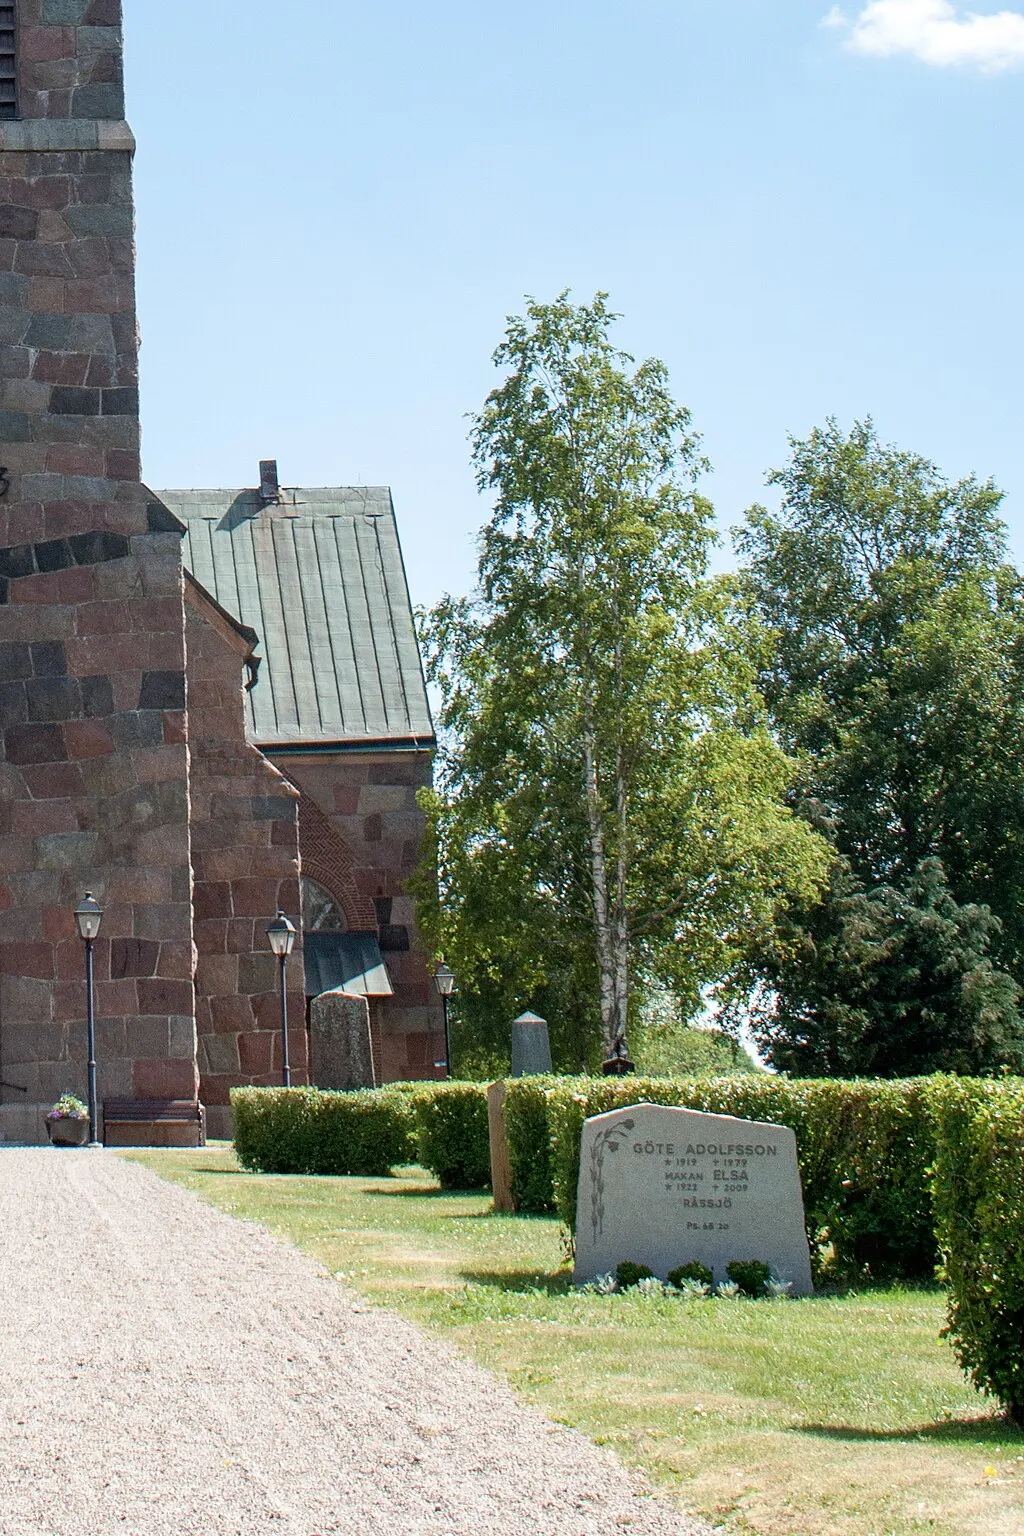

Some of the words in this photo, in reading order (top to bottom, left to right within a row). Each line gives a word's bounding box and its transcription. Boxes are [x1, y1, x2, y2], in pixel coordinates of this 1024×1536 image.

[633, 1141, 675, 1155] GÖTE
[685, 1143, 777, 1156] ADOLFSSON
[675, 1158, 697, 1166] 1919
[665, 1172, 703, 1181] MAKAN
[713, 1169, 749, 1181] ELSA
[676, 1183, 698, 1192] 1922
